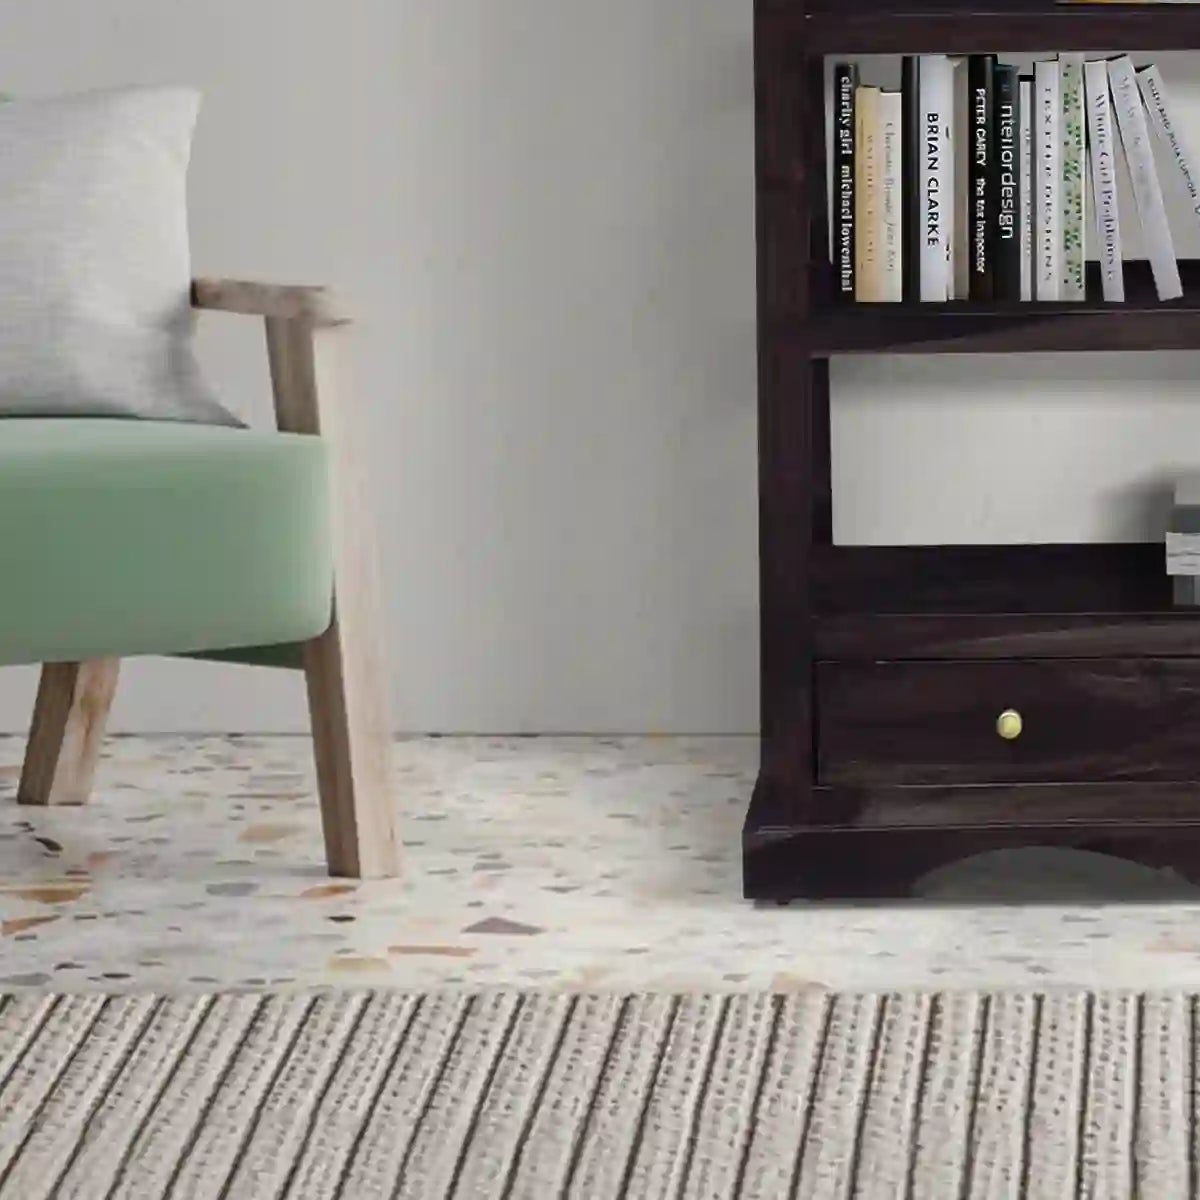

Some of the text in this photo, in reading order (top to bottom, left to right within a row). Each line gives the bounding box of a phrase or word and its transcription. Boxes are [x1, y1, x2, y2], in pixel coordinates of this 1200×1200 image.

[976, 88, 986, 125] PETER
[839, 129, 852, 154] girl
[976, 128, 986, 166] CAREY
[841, 165, 852, 219] michael
[927, 112, 939, 246] BRIAN CLARKE
[841, 223, 852, 291] lowenthal
